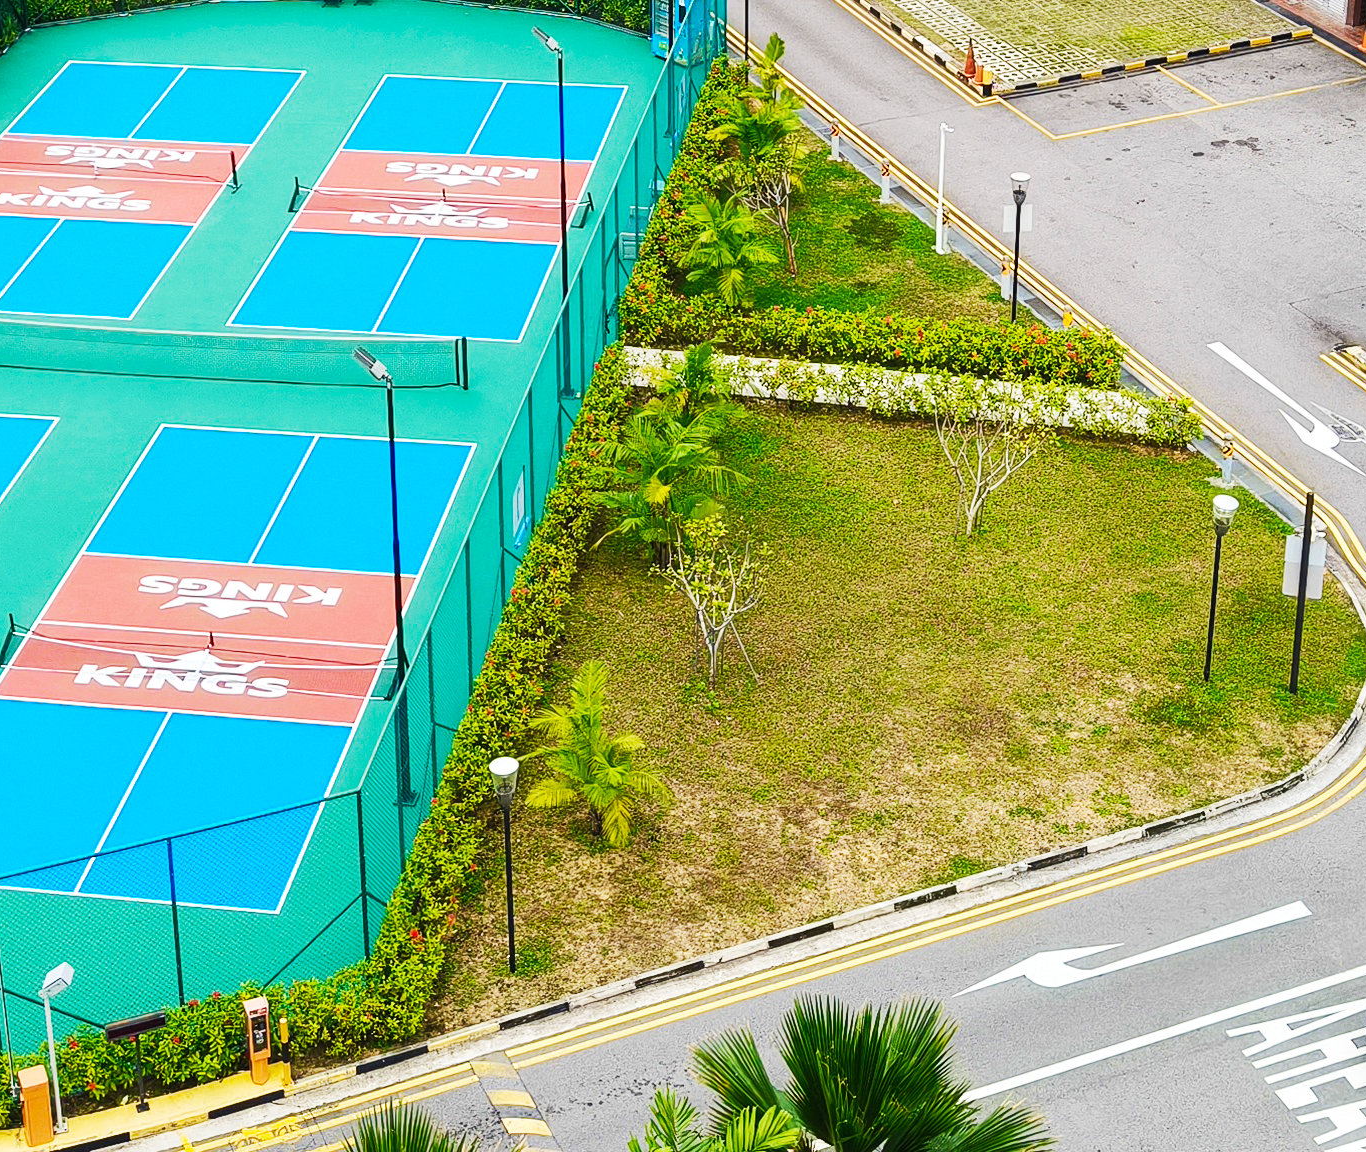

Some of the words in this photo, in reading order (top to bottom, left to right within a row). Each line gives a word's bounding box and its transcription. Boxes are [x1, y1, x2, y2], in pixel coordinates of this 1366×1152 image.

[44, 145, 195, 162] KINGS
[385, 161, 539, 180] KINGS
[349, 211, 510, 230] KINGS
[137, 574, 343, 607] KINGS
[73, 664, 290, 699] KINGS
